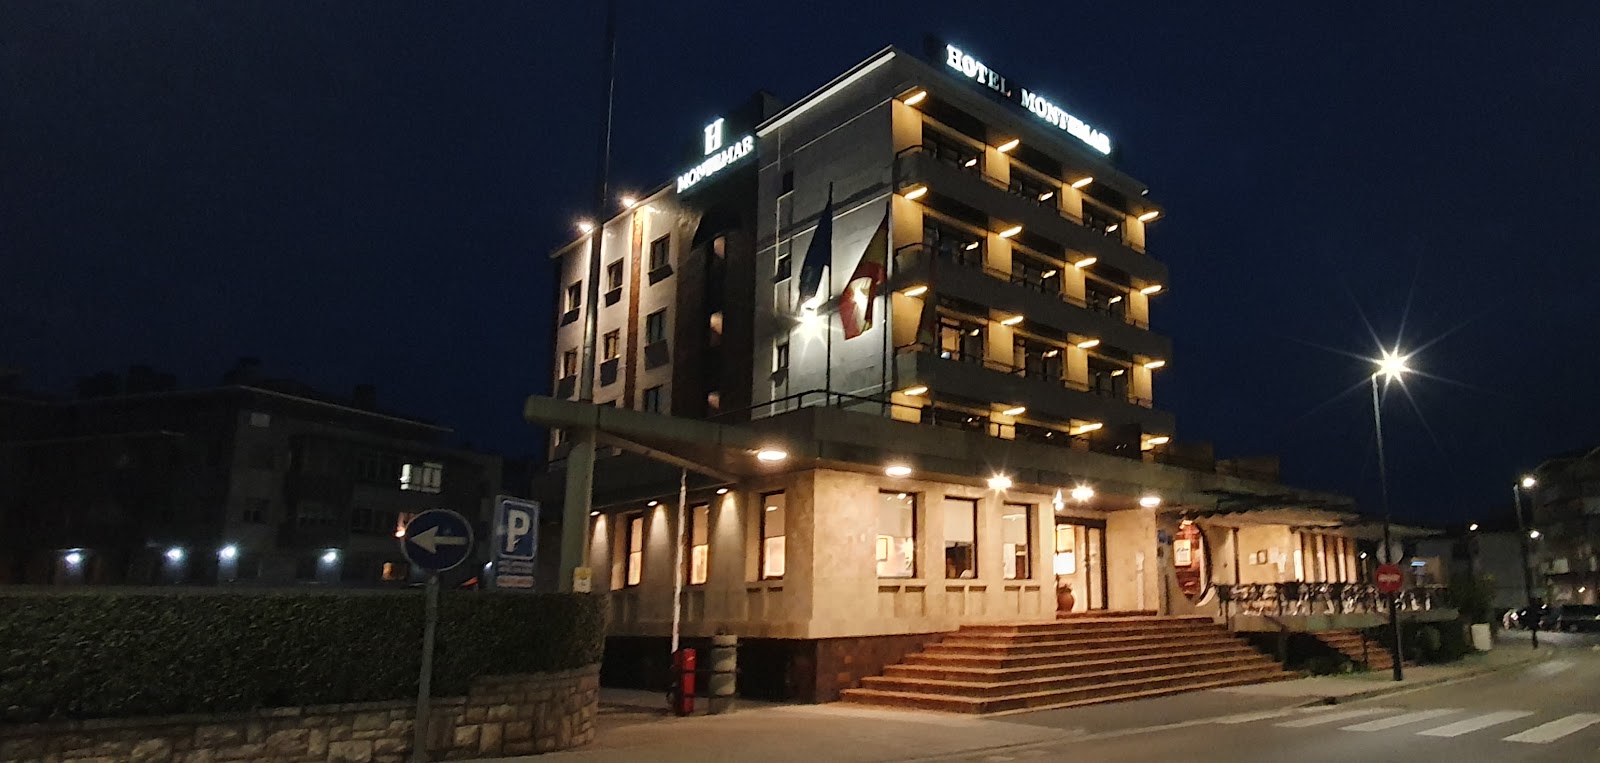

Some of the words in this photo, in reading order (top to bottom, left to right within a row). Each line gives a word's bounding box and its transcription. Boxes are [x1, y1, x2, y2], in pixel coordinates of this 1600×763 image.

[946, 43, 1012, 97] HOTEL
[1020, 87, 1111, 155] MONTEMAR
[704, 117, 725, 155] H
[676, 135, 755, 194] MONTEMAR
[505, 509, 530, 552] P
